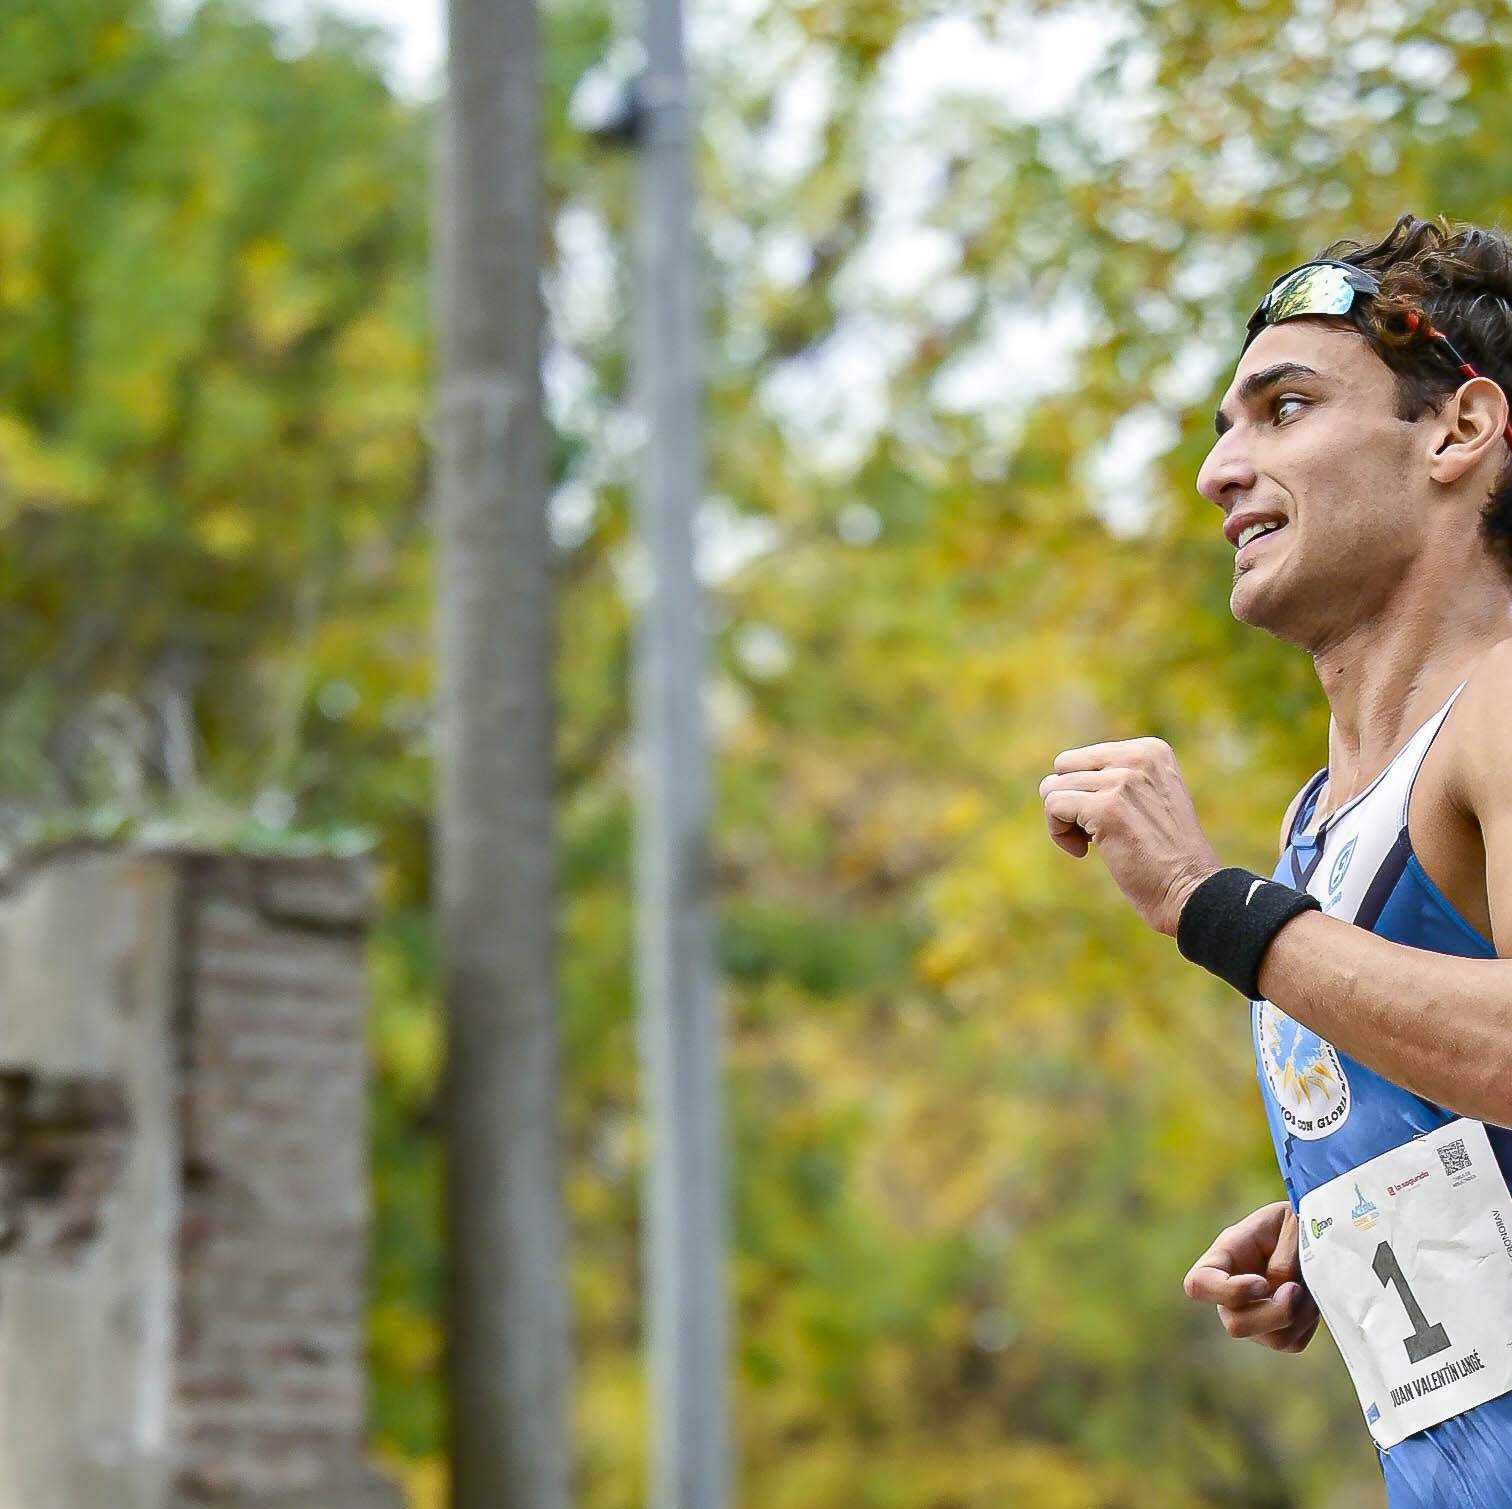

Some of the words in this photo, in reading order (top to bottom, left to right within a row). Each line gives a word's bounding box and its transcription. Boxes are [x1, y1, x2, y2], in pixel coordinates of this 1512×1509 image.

[1372, 1241, 1451, 1364] 1
[1390, 1383, 1414, 1408] JUAN
[1412, 1362, 1460, 1396] VALENTÍN
[1457, 1349, 1485, 1377] LANGÉ
